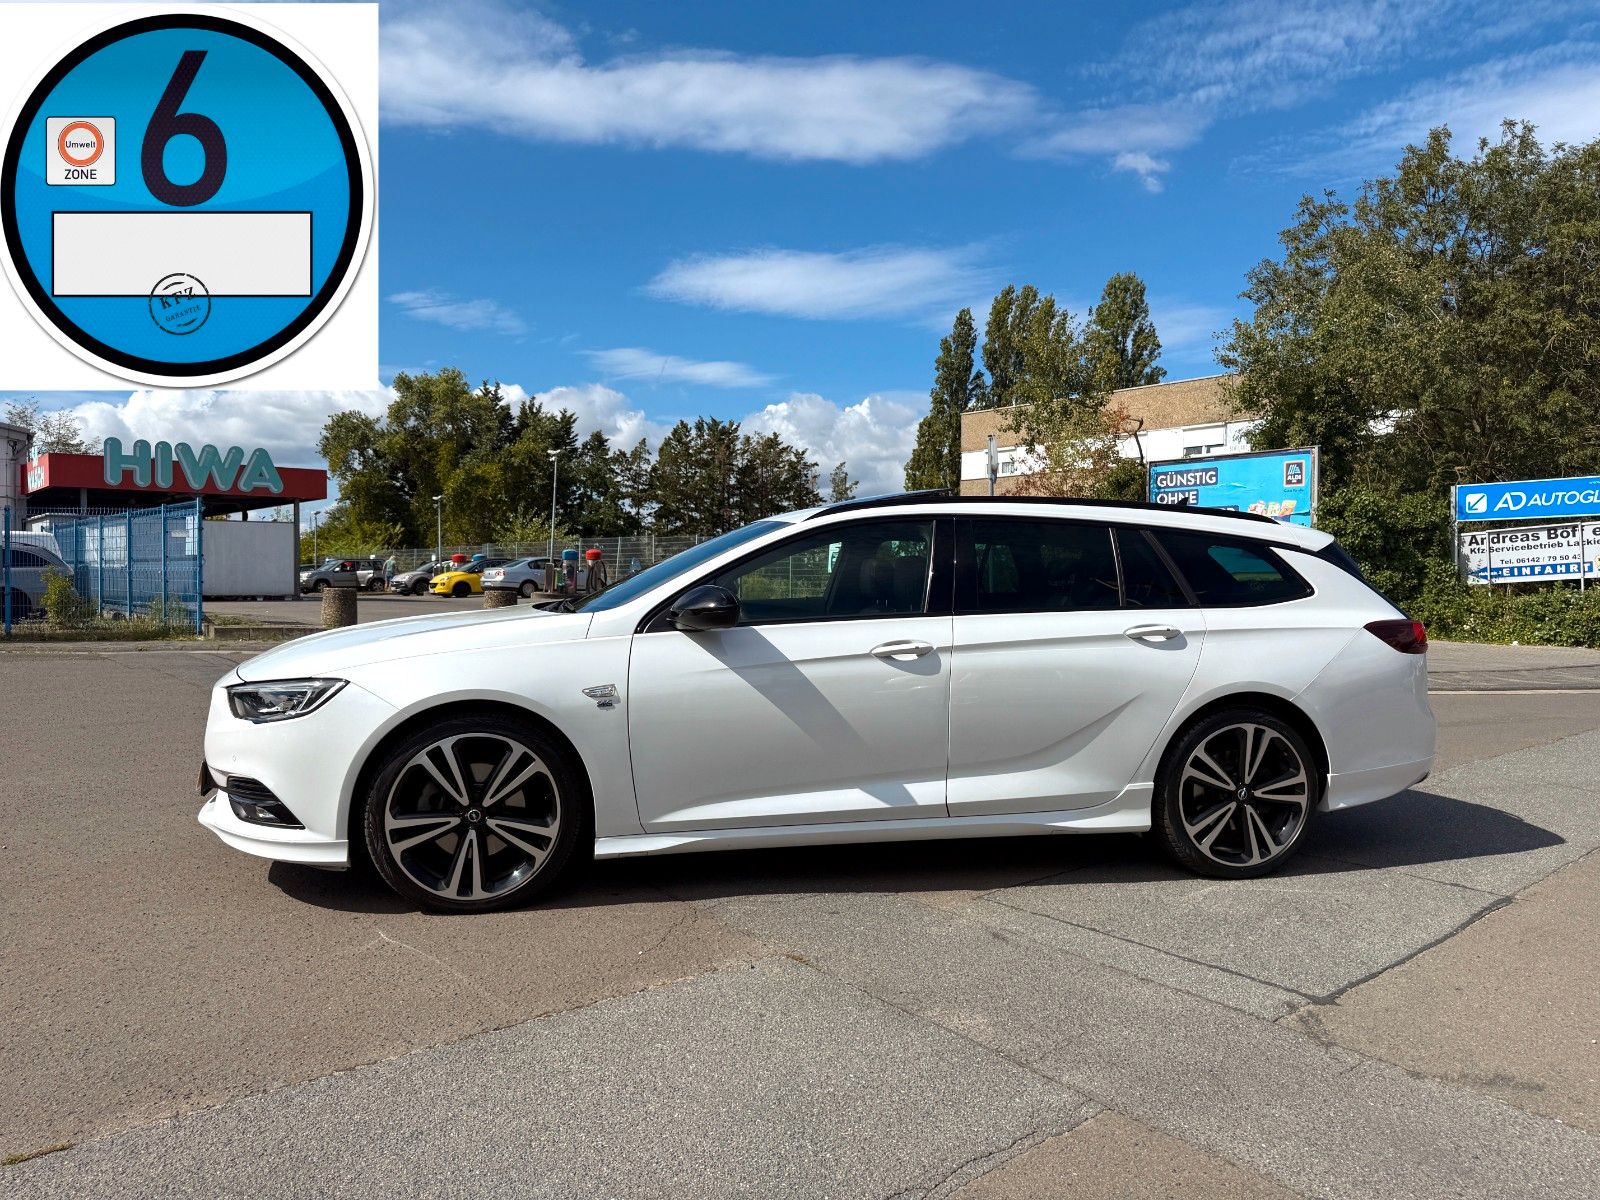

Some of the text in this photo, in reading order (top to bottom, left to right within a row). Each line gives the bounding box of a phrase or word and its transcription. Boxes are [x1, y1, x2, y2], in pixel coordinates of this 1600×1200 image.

[103, 436, 284, 494] HIWA
[1156, 470, 1217, 488] GÜNSTIG
[1156, 491, 1198, 505] OHNE
[1516, 556, 1540, 564] 06142
[1503, 563, 1591, 576] EINFAHRT
